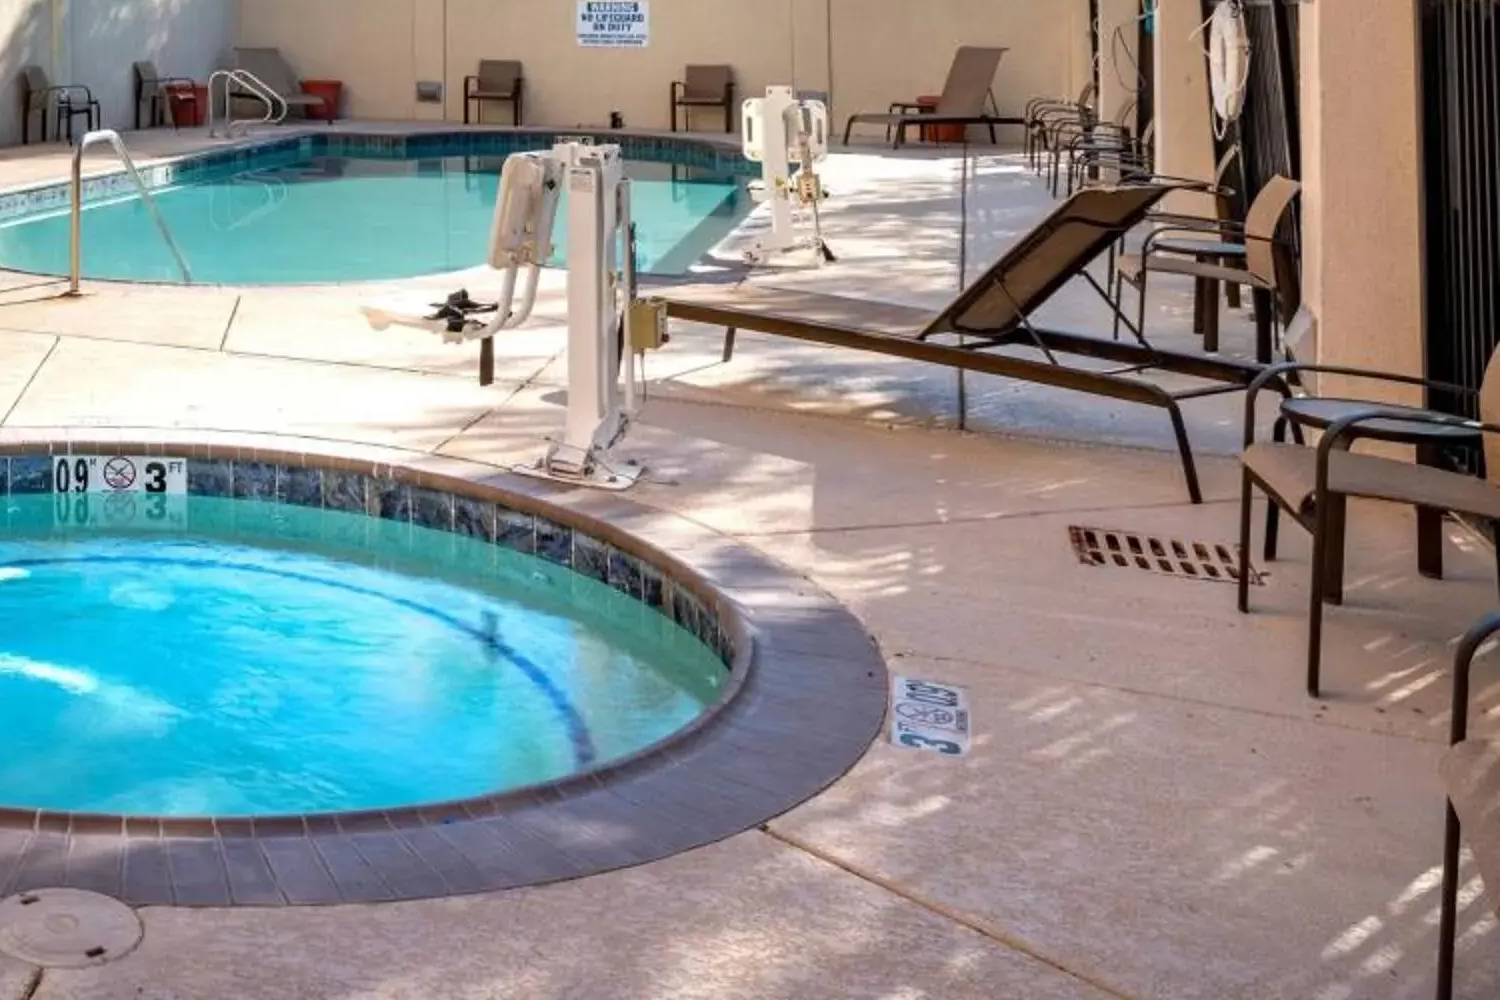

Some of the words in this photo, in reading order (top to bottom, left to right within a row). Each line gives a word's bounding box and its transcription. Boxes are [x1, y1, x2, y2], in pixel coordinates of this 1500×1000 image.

[581, 13, 594, 22] NO
[595, 13, 645, 22] LIFEGUARD
[593, 23, 605, 31] ON
[608, 23, 632, 32] DUTY
[145, 462, 167, 493] 3
